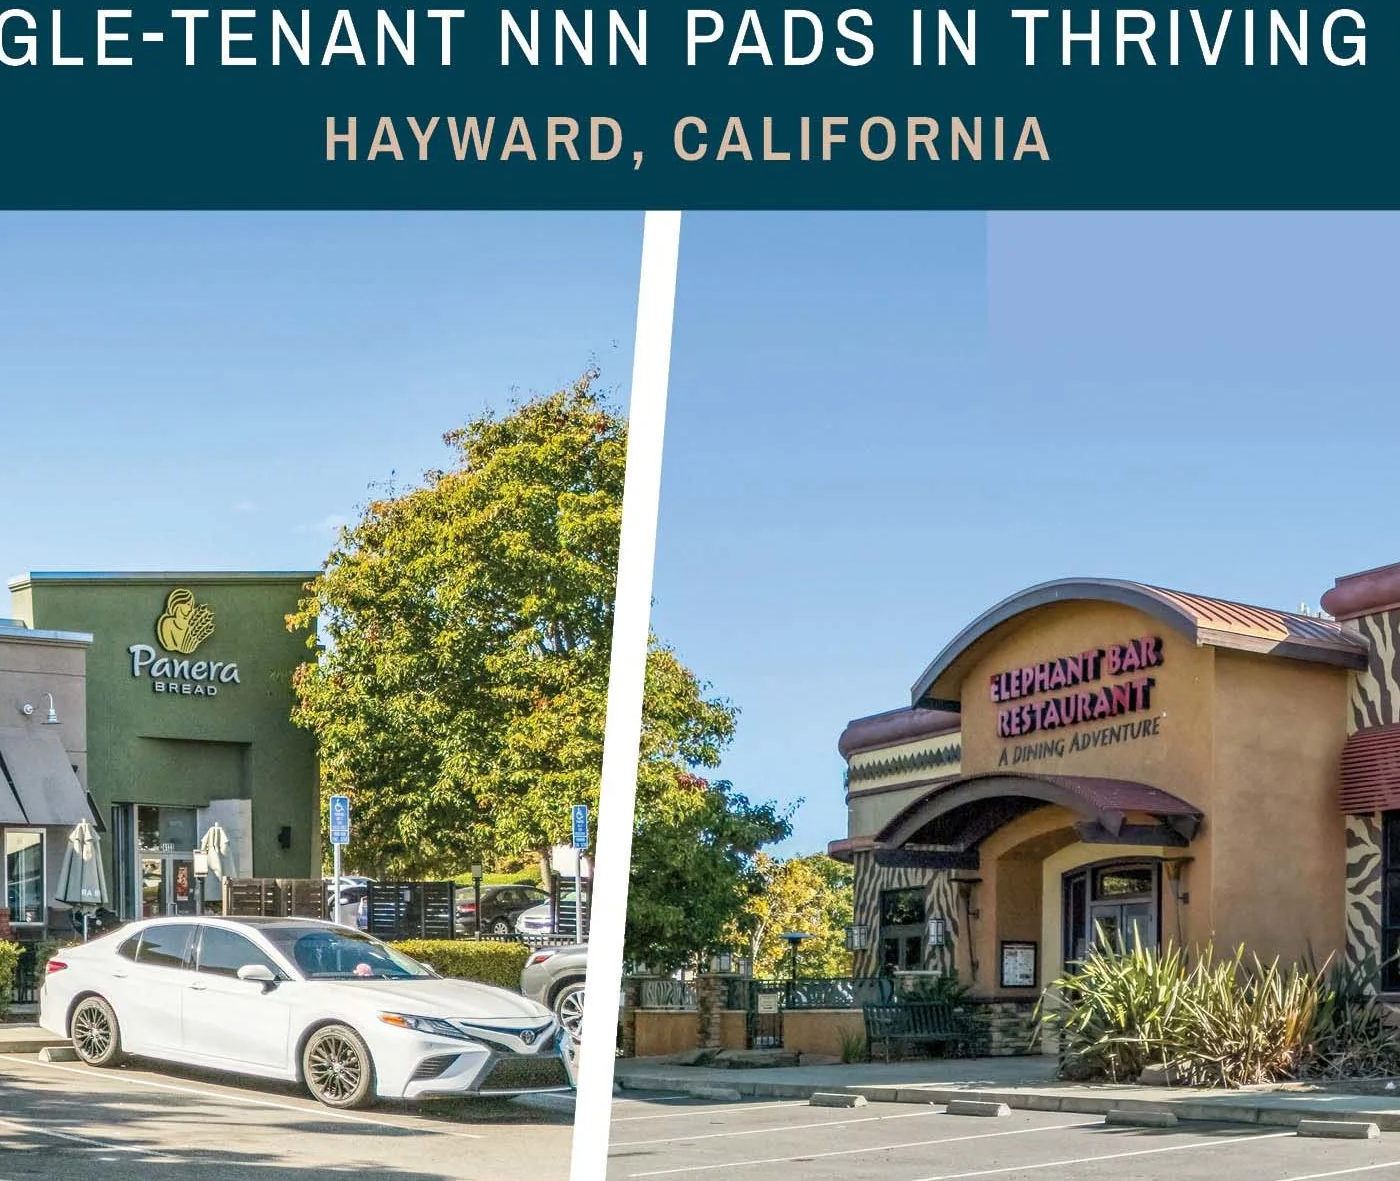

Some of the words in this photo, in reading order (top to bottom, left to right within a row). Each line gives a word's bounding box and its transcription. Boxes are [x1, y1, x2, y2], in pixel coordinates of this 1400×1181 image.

[129, 644, 240, 683] Panera
[154, 681, 217, 695] BREAD
[990, 649, 1102, 702] ELEPHANT
[1107, 636, 1162, 674] BAR
[998, 678, 1153, 737] RESTAURANT
[998, 748, 1008, 766] A
[1012, 738, 1065, 764] DINING
[1069, 716, 1161, 753] ADVENTURE
